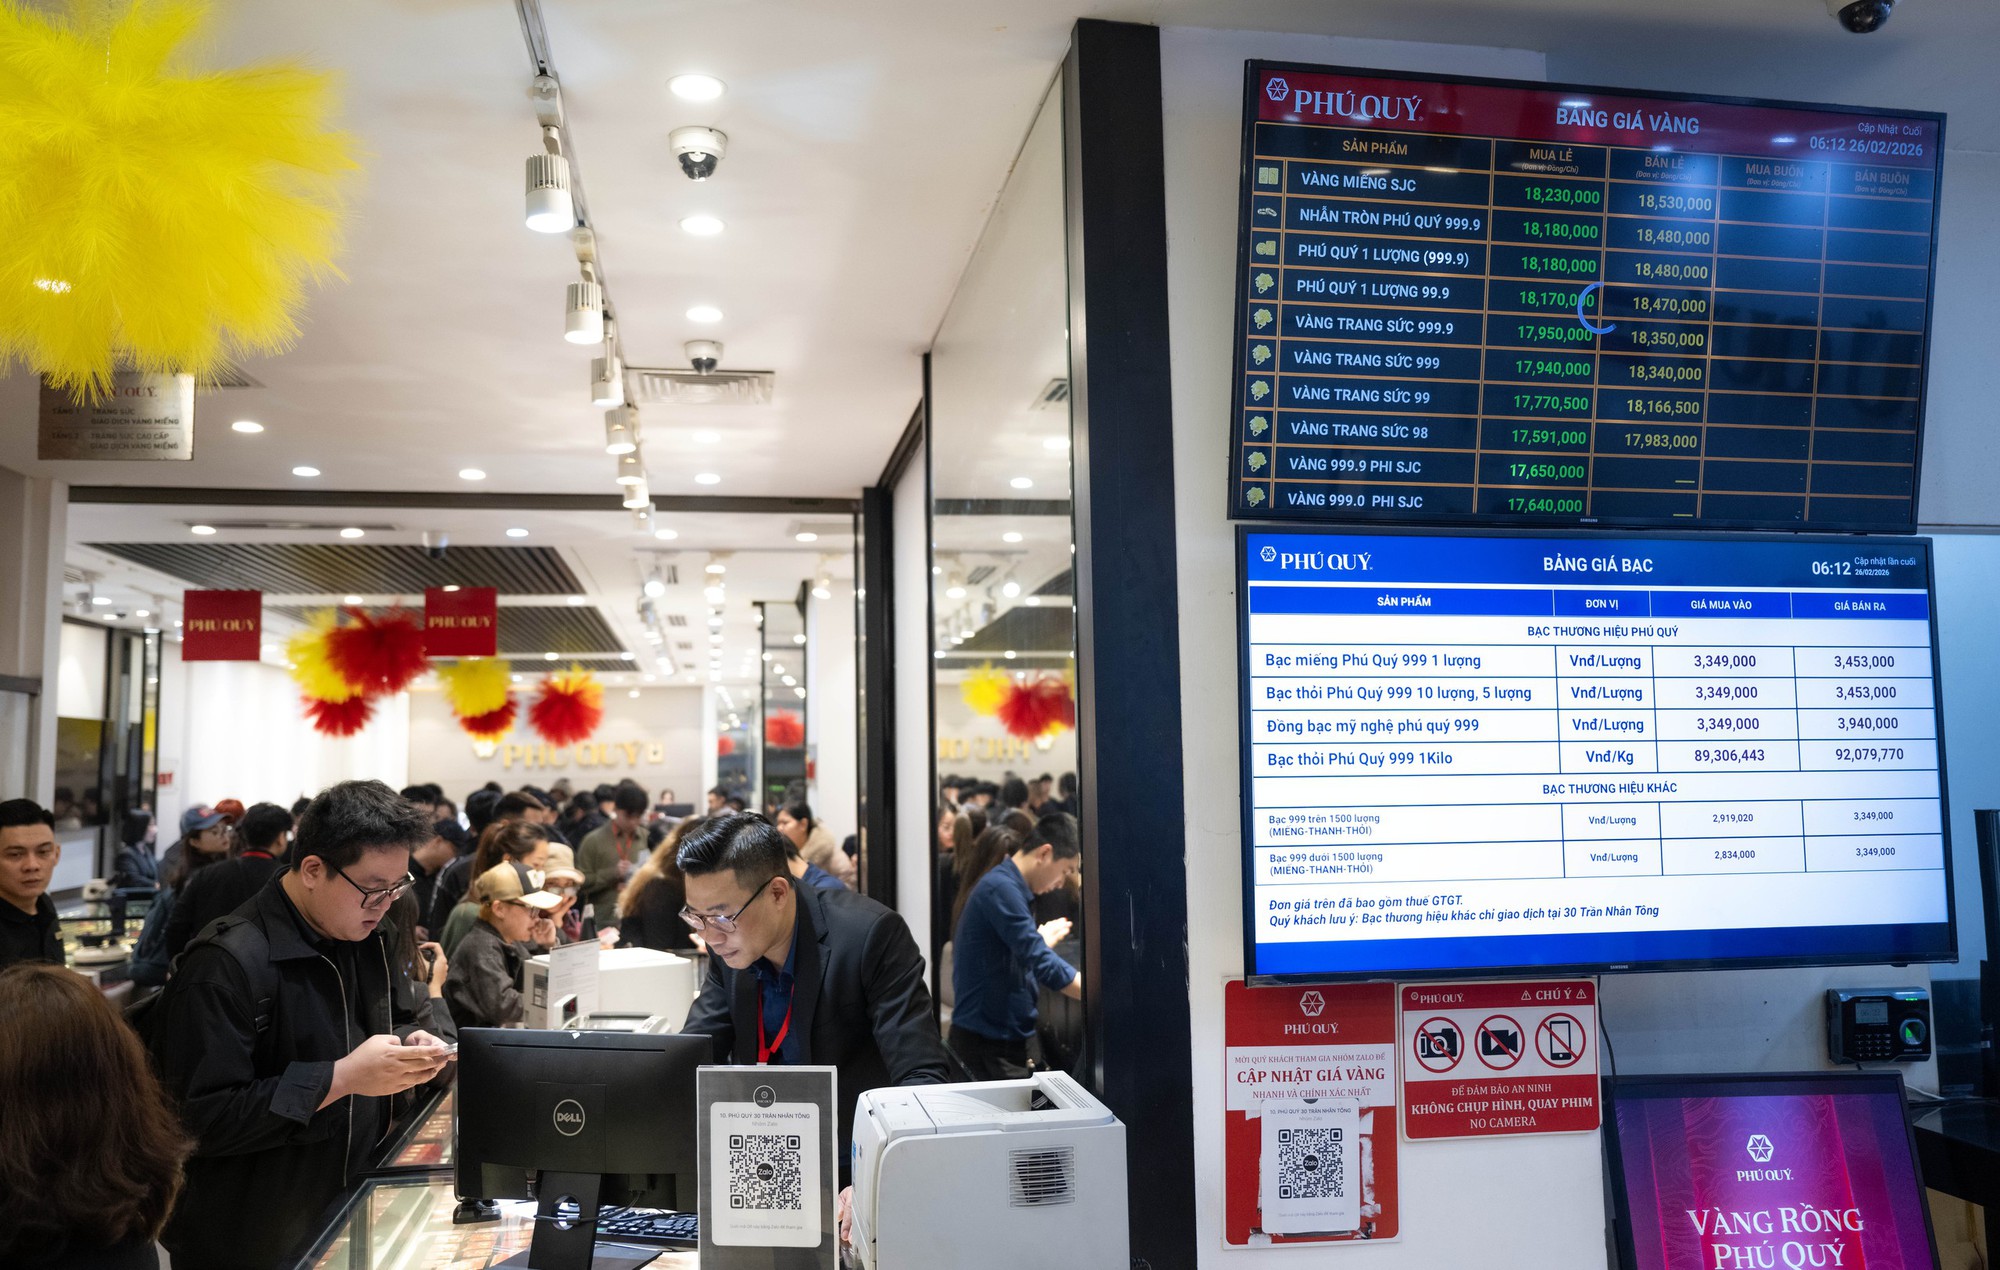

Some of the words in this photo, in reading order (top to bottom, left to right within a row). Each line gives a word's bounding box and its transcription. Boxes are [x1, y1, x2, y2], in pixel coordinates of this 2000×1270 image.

[1294, 90, 1354, 117] PHÚ
[1360, 95, 1422, 121] QUÝ
[1613, 110, 1644, 130] GIÁ
[1650, 112, 1699, 134] VÀNG
[1858, 123, 1875, 135] Cập
[1878, 124, 1898, 136] Nhật
[1902, 125, 1922, 136] Cuối
[1343, 138, 1368, 152] SẢN
[1372, 140, 1408, 155] PHẨM
[1810, 136, 1846, 151] 06:12
[1849, 138, 1923, 156] 26/02/2026
[1530, 148, 1556, 161] MUA
[1560, 148, 1572, 162] LẺ
[1645, 155, 1668, 168] BÁN
[1746, 164, 1770, 176] MUA
[1774, 164, 1804, 178] BUÔN
[1855, 170, 1877, 182] BÁN
[1880, 172, 1910, 184] BUÔN
[1301, 172, 1340, 187] VÀNG
[1343, 174, 1386, 190] MIẾNG
[1390, 178, 1416, 192] SJC
[1524, 187, 1600, 204] 18,230,000
[1639, 194, 1712, 212] 18,530,000
[1300, 206, 1339, 223] NHẪN
[1343, 210, 1380, 225] TRÒN
[1382, 212, 1411, 227] PHÚ
[1415, 214, 1442, 229] QUÝ
[1445, 218, 1481, 231] 999.9
[1523, 222, 1598, 239] 18,180,000
[1637, 228, 1710, 246] 18,480,000
[1296, 314, 1333, 330] VÀNG
[1337, 318, 1383, 332] TRANG
[1386, 318, 1414, 332] SỨC
[1418, 322, 1454, 334] 999.9
[1631, 330, 1704, 347] 18,350,000
[1280, 552, 1323, 570] PHÚ
[1328, 553, 1371, 570] QUÝ
[1544, 553, 1588, 572] BẢNG
[1592, 555, 1618, 572] GIÁ
[1622, 558, 1654, 574] BẠC
[1854, 557, 1869, 566] Cập
[1870, 557, 1886, 566] nhật
[1900, 557, 1916, 566] cuối
[1812, 562, 1851, 576] 06:12
[1377, 594, 1398, 606] SẢN
[1400, 594, 1431, 606] PHẨM
[1586, 599, 1606, 608] ĐƠN
[1609, 600, 1618, 610] VỊ
[1691, 599, 1707, 609] GIÁ
[1710, 601, 1730, 609] MUA
[1732, 599, 1752, 609] VÀO
[1834, 600, 1850, 610] GIÁ
[1852, 600, 1871, 610] BÁN
[1528, 626, 1550, 638] BẠC
[1554, 626, 1600, 636] THƯƠNG
[1604, 626, 1628, 638] HIỆU
[1632, 626, 1653, 636] PHÚ
[1657, 626, 1678, 637] QUÝ
[1266, 654, 1291, 668] Bạc
[1296, 652, 1338, 668] miếng
[1342, 652, 1368, 666] Phú
[1372, 653, 1398, 669] Quý
[1402, 654, 1427, 666] 999
[1432, 654, 1438, 666] 1
[1444, 654, 1481, 669] lượng
[1570, 654, 1641, 670] Vnđ/Lượng
[1694, 655, 1756, 670] 3,349,000
[1834, 656, 1894, 669] 3,453,000
[1268, 753, 1294, 768] Bạc
[1298, 751, 1324, 766] thỏi
[1328, 752, 1354, 766] Phú
[1358, 752, 1384, 768] Quý
[1389, 752, 1414, 764] 999
[1419, 752, 1452, 764] 1Kilo
[1586, 750, 1634, 765] Vnđ/Kg
[1695, 750, 1764, 764] 89,306,443
[1836, 748, 1904, 762] 92,079,770
[1268, 815, 1286, 824] Bạc
[1288, 815, 1306, 824] 999
[1308, 815, 1327, 824] trên
[1330, 814, 1352, 823] 1500
[1354, 814, 1380, 825] lượng
[1588, 816, 1636, 826] Vnđ/Lượng
[1713, 815, 1754, 824] 2,919,020
[1270, 900, 1290, 910] Đơn
[1294, 898, 1310, 912] giá
[1314, 898, 1335, 909] trên
[1338, 897, 1352, 908] đã
[1356, 897, 1375, 908] bao
[1378, 896, 1402, 909] gồm
[1406, 894, 1429, 906] thuế
[1432, 895, 1463, 906] GTGT.
[1420, 993, 1441, 1004] PHÚ
[1442, 992, 1464, 1002] QUÝ
[1536, 988, 1560, 1000] CHÚ
[1564, 988, 1572, 999] Ý
[1284, 1022, 1310, 1034] PHÚ
[1312, 1022, 1338, 1034] QUÝ
[1252, 1056, 1266, 1064] QUÝ
[1237, 1068, 1266, 1086] CẬP
[1271, 1066, 1312, 1085] NHẬT
[1317, 1066, 1342, 1081] GIÁ
[1346, 1066, 1384, 1080] VÀNG
[1252, 1090, 1284, 1098] NHANH
[1286, 1090, 1298, 1098] VÀ
[1300, 1088, 1327, 1098] CHÍNH
[1329, 1088, 1346, 1096] XÁC
[1348, 1087, 1371, 1096] NHẤT
[1452, 1085, 1464, 1096] ĐỂ
[1467, 1084, 1488, 1095] ĐẢM
[1490, 1084, 1509, 1094] BẢO
[1512, 1085, 1524, 1093] AN
[1528, 1084, 1552, 1092] NINH
[1412, 1102, 1454, 1114] KHÔNG
[1457, 1102, 1488, 1115] CHỤP
[1492, 1098, 1525, 1111] HÌNH,
[1528, 1099, 1558, 1110] QUAY
[1562, 1098, 1592, 1107] PHIM
[557, 1112, 582, 1122] DELL
[1470, 1118, 1486, 1128] NO
[1490, 1116, 1536, 1128] CAMERA
[758, 1168, 772, 1176] Zalo
[1736, 1168, 1764, 1182] PHÚ
[1766, 1167, 1793, 1180] QUÝ
[1686, 1206, 1773, 1236] VÀNG
[1778, 1203, 1864, 1233] RỒNG
[1711, 1240, 1775, 1270] PHÚ
[1782, 1238, 1846, 1270] QUÝ
